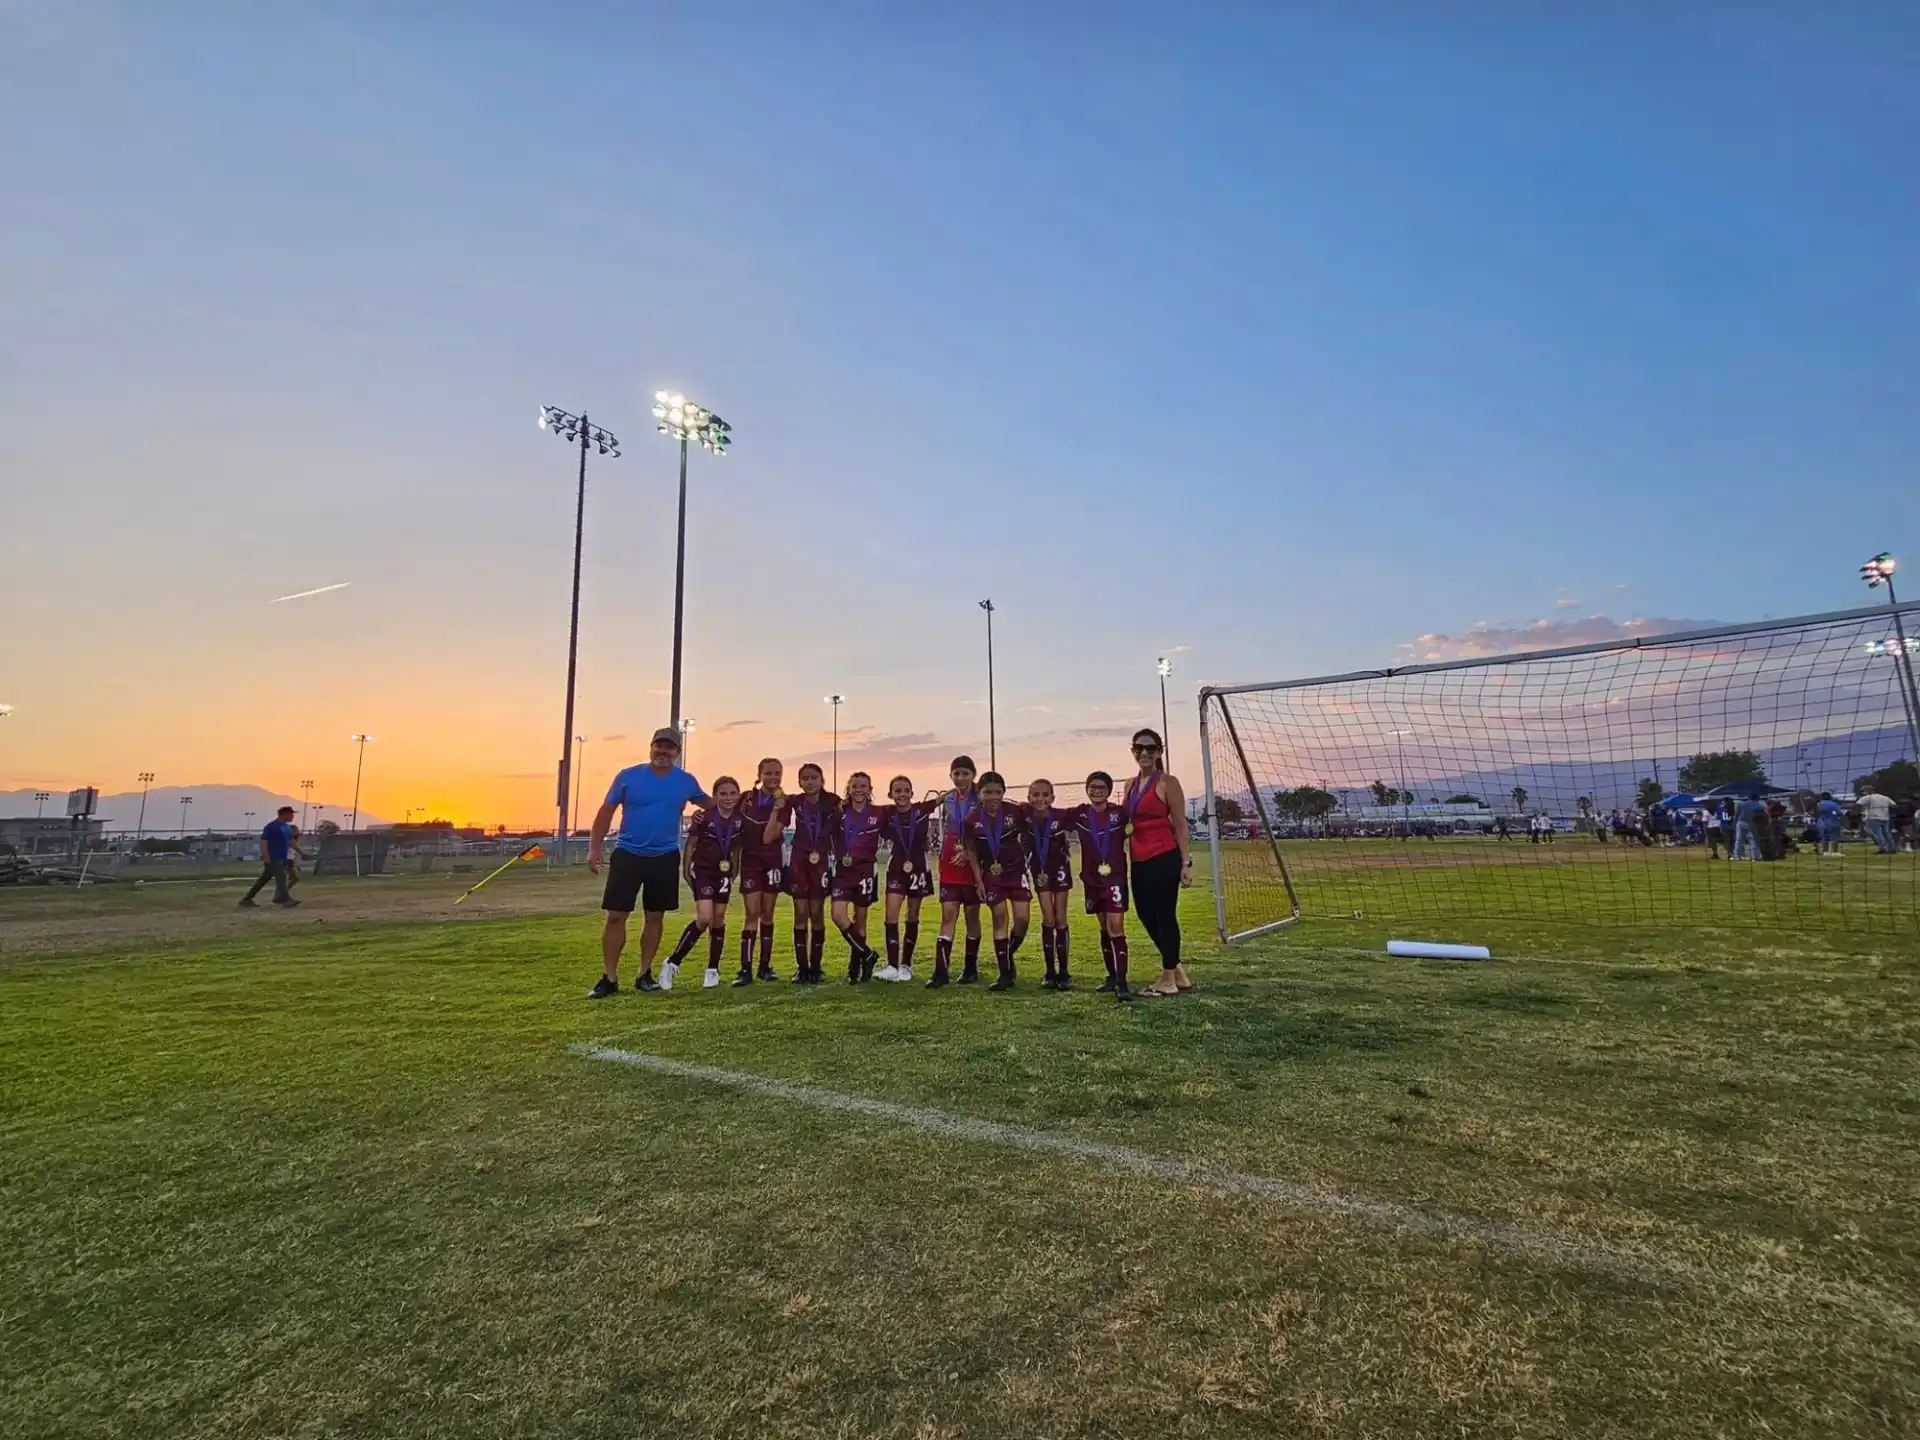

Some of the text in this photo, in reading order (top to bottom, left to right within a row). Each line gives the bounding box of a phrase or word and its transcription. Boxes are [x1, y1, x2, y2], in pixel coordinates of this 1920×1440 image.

[767, 869, 781, 885] 10
[822, 871, 829, 888] 6
[910, 873, 926, 890] 24
[859, 877, 873, 895] 13
[1110, 886, 1121, 902] 3
